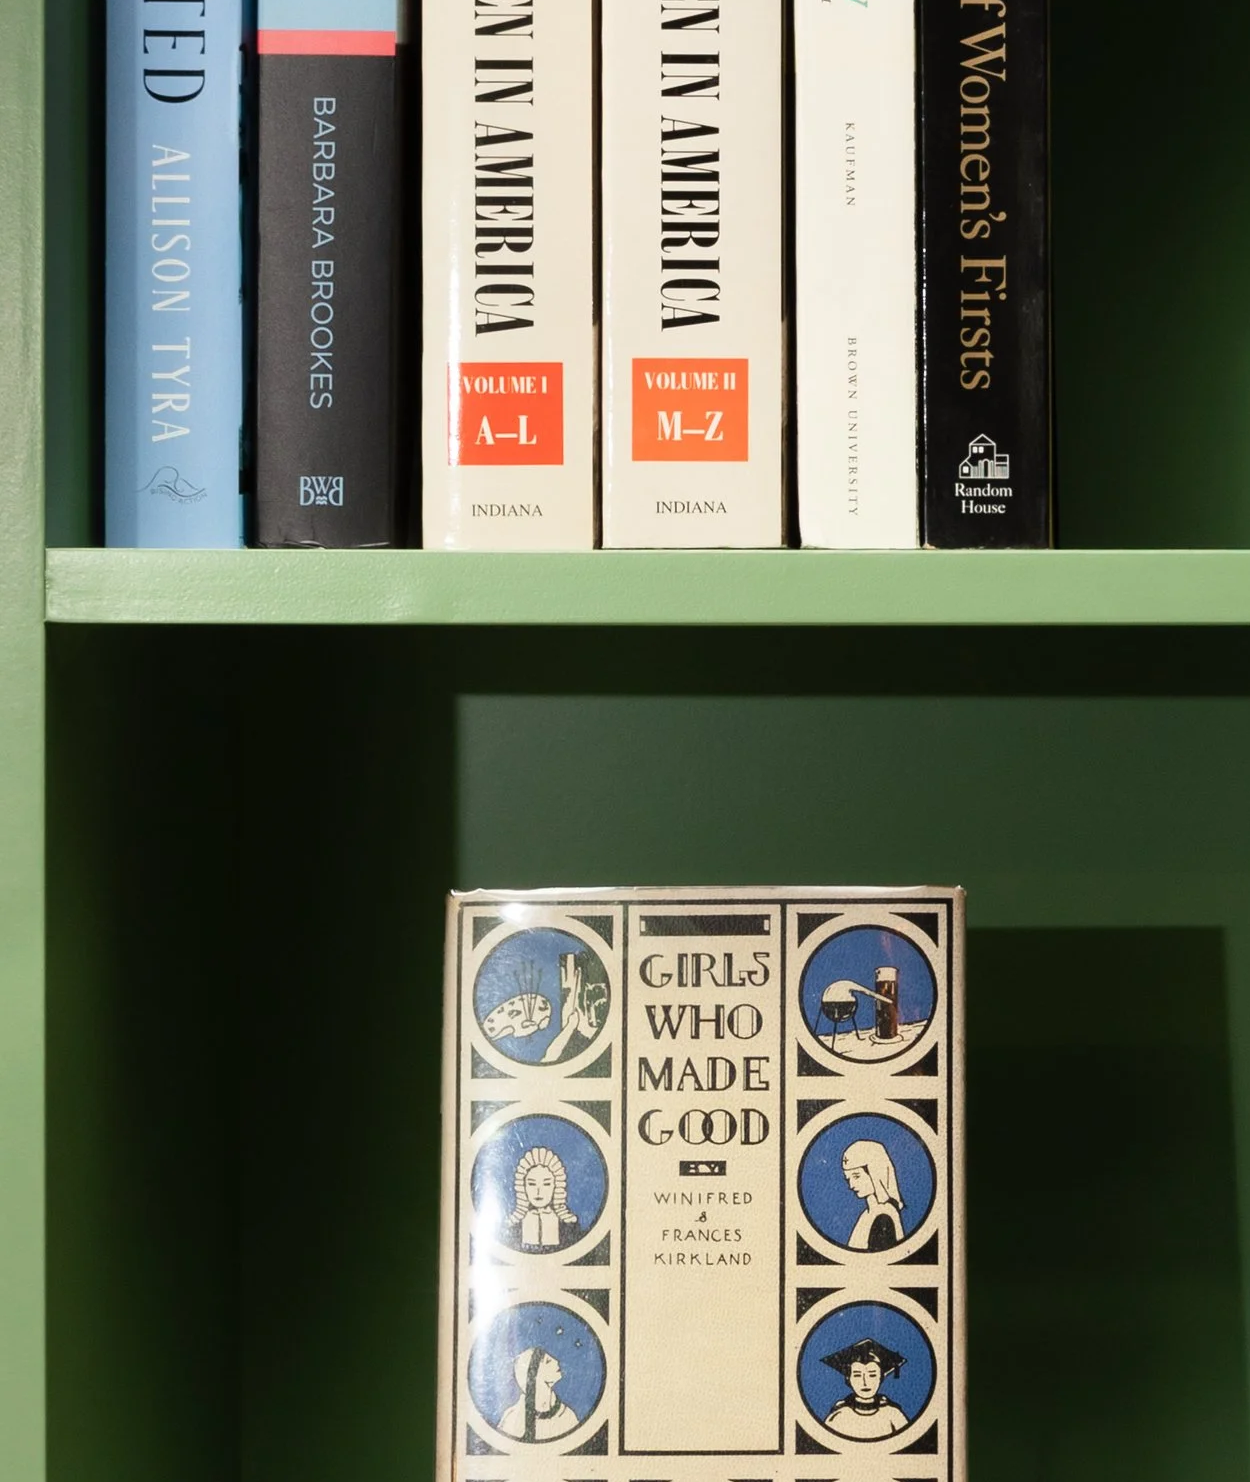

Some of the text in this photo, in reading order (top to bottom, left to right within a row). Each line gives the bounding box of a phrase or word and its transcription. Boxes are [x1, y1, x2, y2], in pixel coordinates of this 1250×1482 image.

[474, 57, 535, 106] IN
[844, 122, 856, 207] KAUFMAN
[474, 122, 535, 337] AMERICA
[309, 97, 337, 409] BARBARA BROOKES
[151, 144, 191, 443] ALLISON TYRA
[959, 255, 1007, 391] Firsts
[462, 376, 548, 394] VOLUME I
[644, 372, 737, 390] VOLUME II
[954, 483, 1013, 498] Random
[961, 500, 1006, 514] House
[471, 503, 544, 517] INDIANA
[639, 951, 770, 990] GIRLS
[644, 1003, 763, 1041] WHO
[637, 1056, 770, 1093] MADE
[638, 1107, 770, 1146] GOOD
[654, 1192, 753, 1206] WINIFRED
[662, 1228, 743, 1243] FRANCES
[654, 1252, 752, 1265] KIRKLAND
